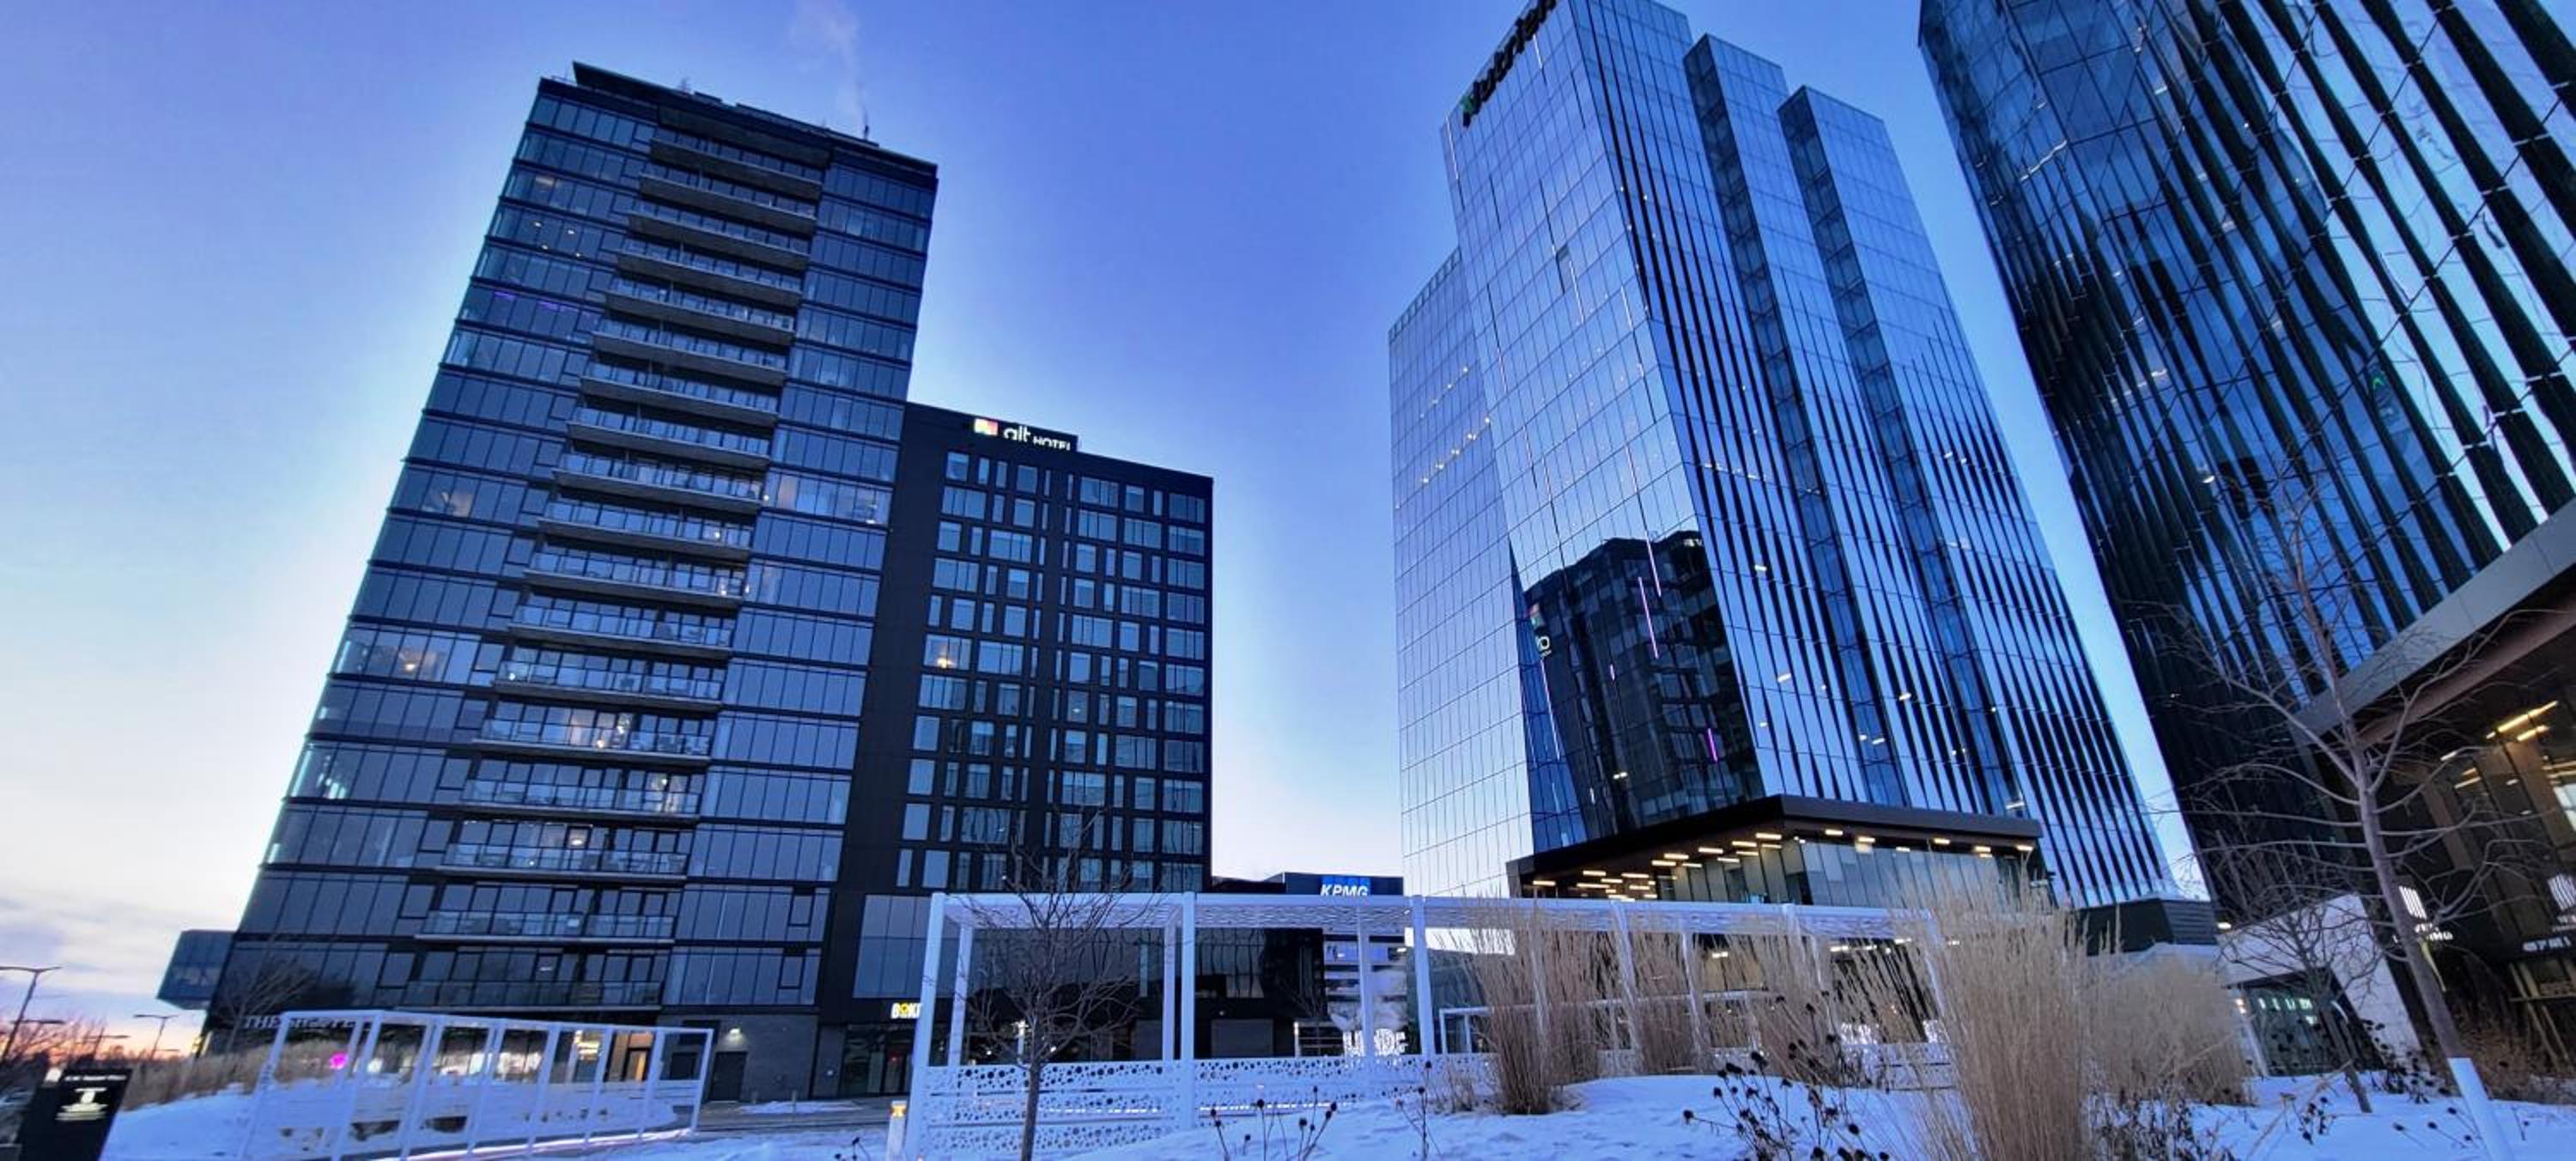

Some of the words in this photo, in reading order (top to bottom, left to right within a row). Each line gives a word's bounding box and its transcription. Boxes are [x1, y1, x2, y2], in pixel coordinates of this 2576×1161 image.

[1003, 425, 1031, 443] alt
[1033, 435, 1072, 451] HOTEL
[1320, 883, 1369, 897] KPMG
